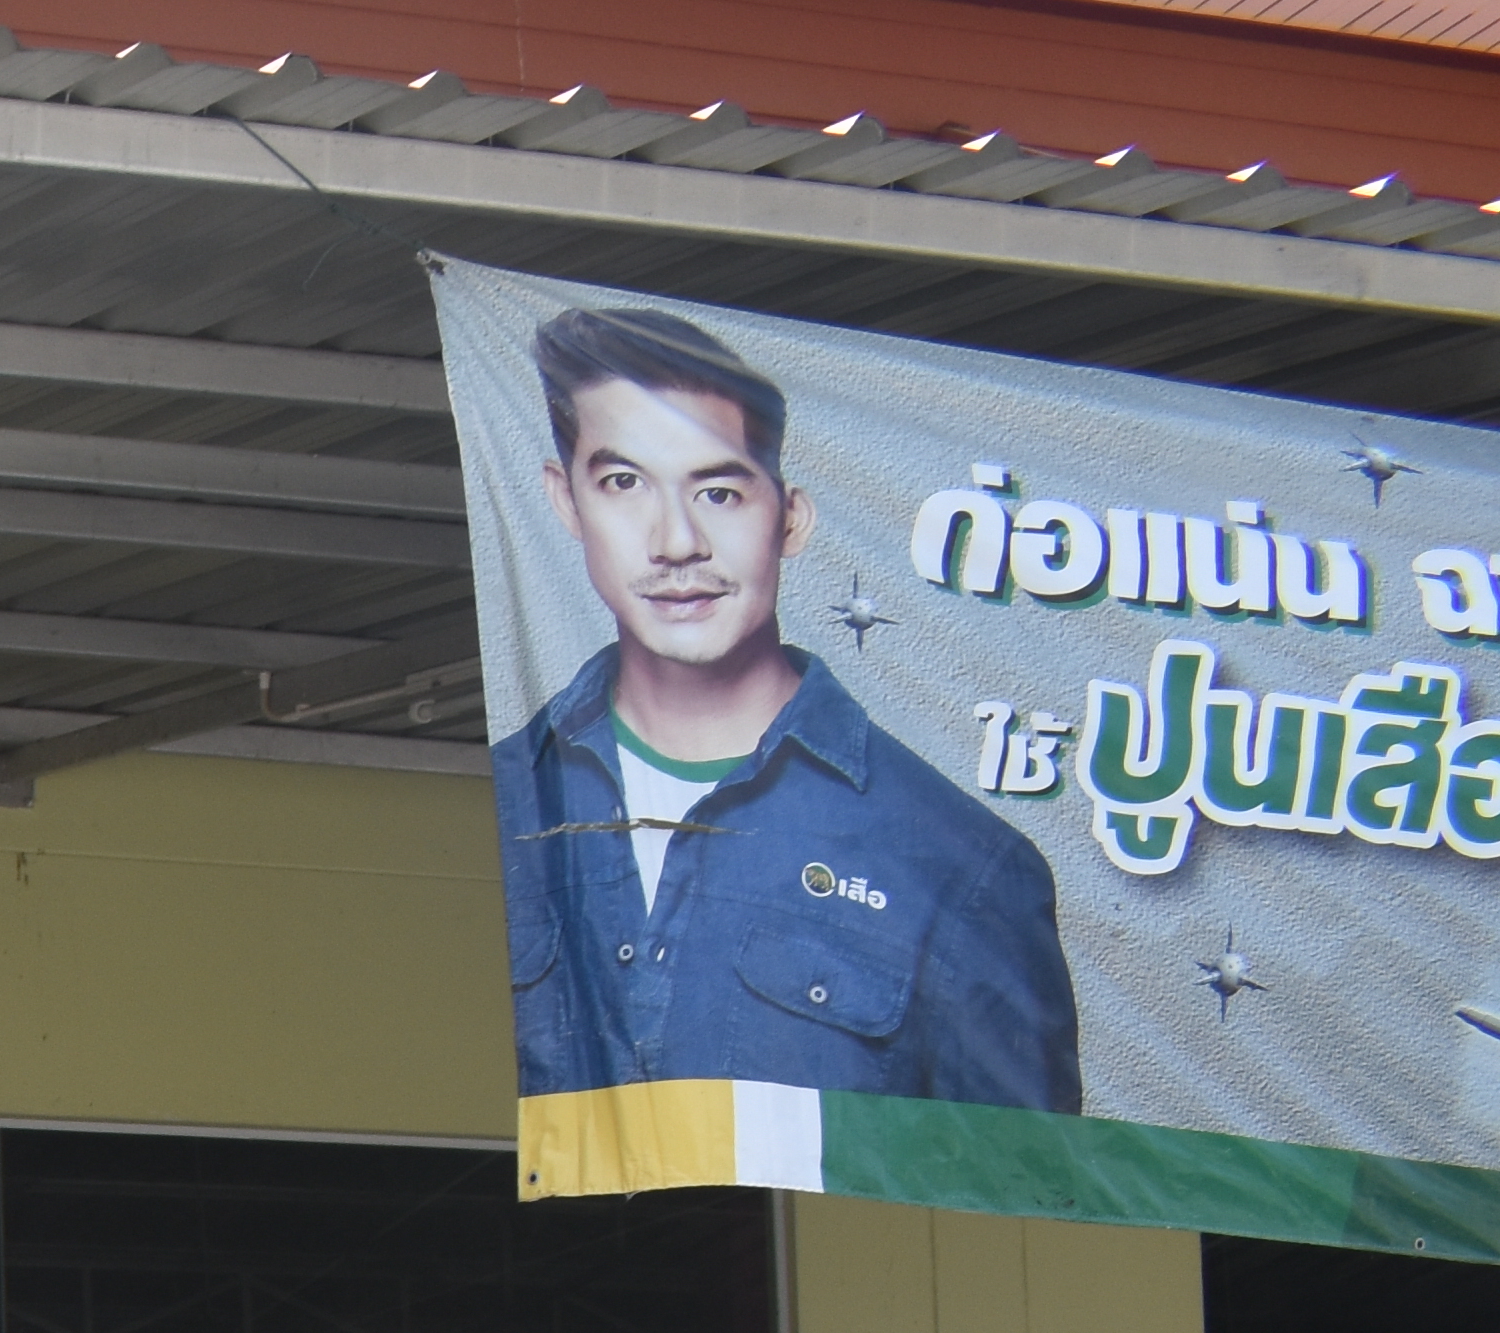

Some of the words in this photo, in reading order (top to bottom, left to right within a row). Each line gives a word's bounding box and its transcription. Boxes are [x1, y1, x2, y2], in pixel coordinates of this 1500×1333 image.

[911, 463, 1368, 632] ก่อแน่น
[1412, 547, 1500, 642] ฉ
[974, 701, 1068, 797] ใช้
[838, 877, 887, 909] เสือ
